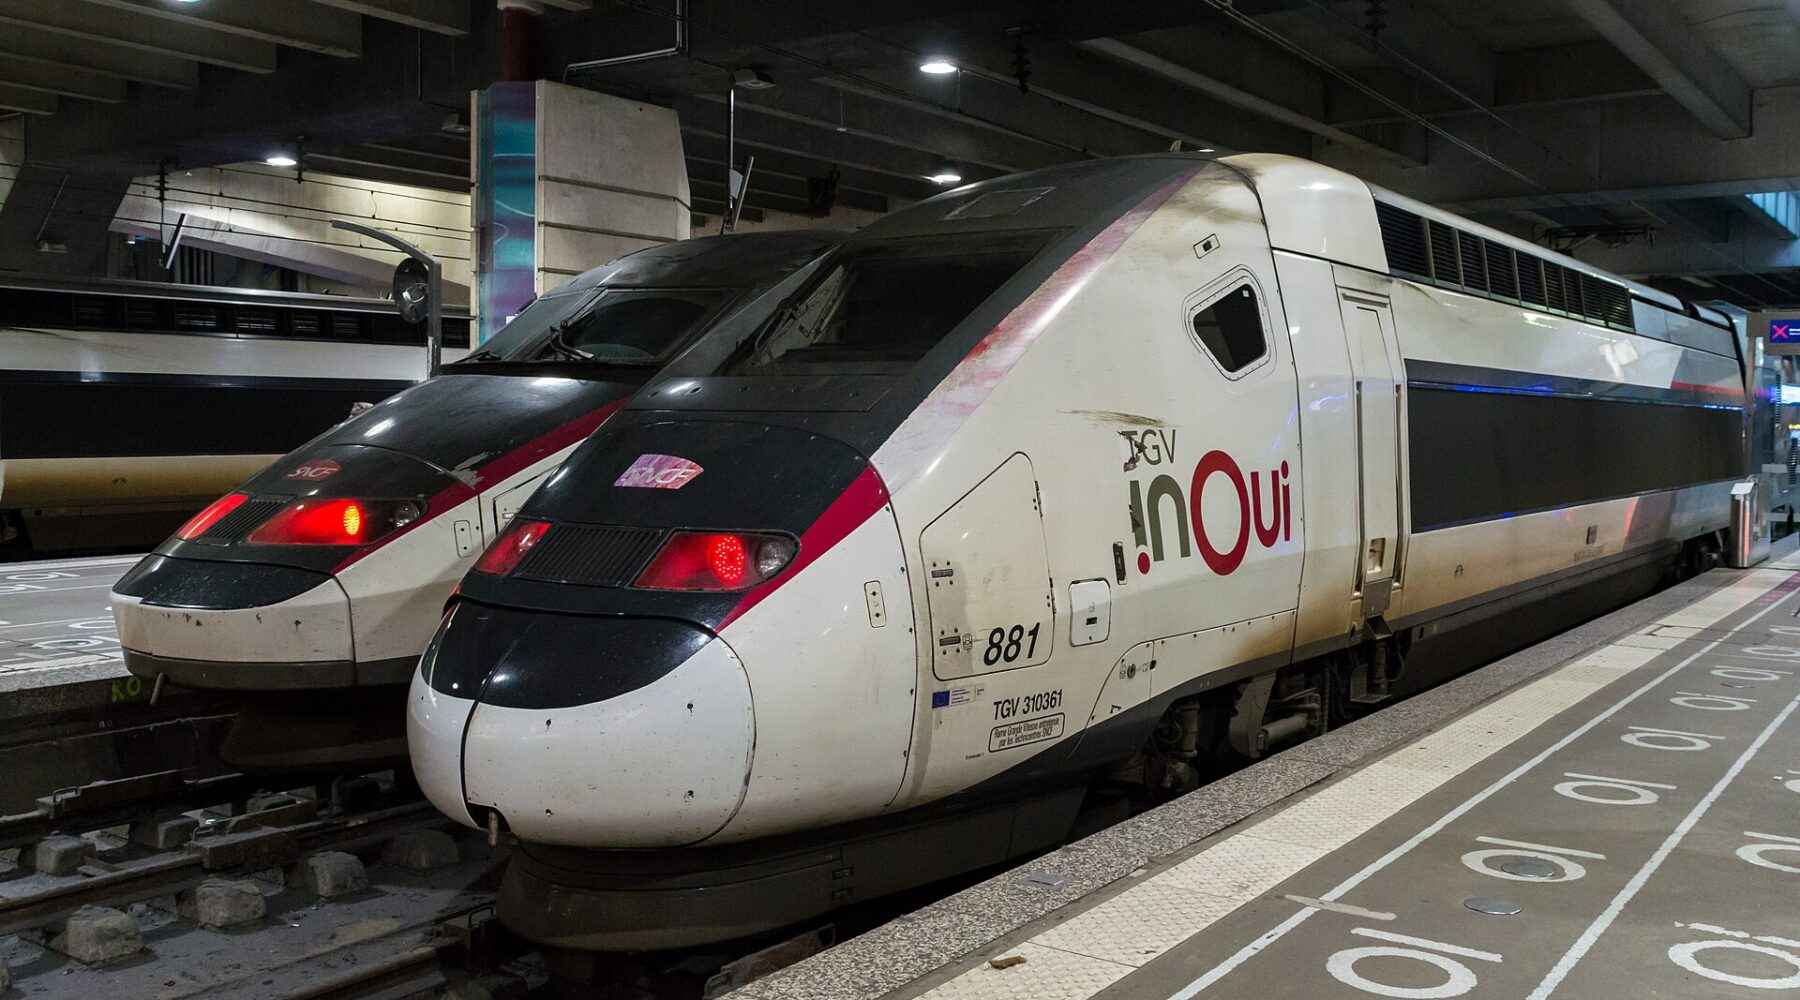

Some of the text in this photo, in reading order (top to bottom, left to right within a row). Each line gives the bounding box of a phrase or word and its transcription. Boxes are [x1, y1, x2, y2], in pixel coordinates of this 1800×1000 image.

[1120, 429, 1176, 466] TGV
[287, 466, 339, 478] SNCF
[620, 467, 698, 484] SNCF
[983, 622, 1041, 666] 881
[993, 689, 1063, 721] TGV 310361
[1007, 724, 1023, 736] Grande
[1023, 722, 1039, 732] Vitesse
[1041, 726, 1054, 738] SNCF
